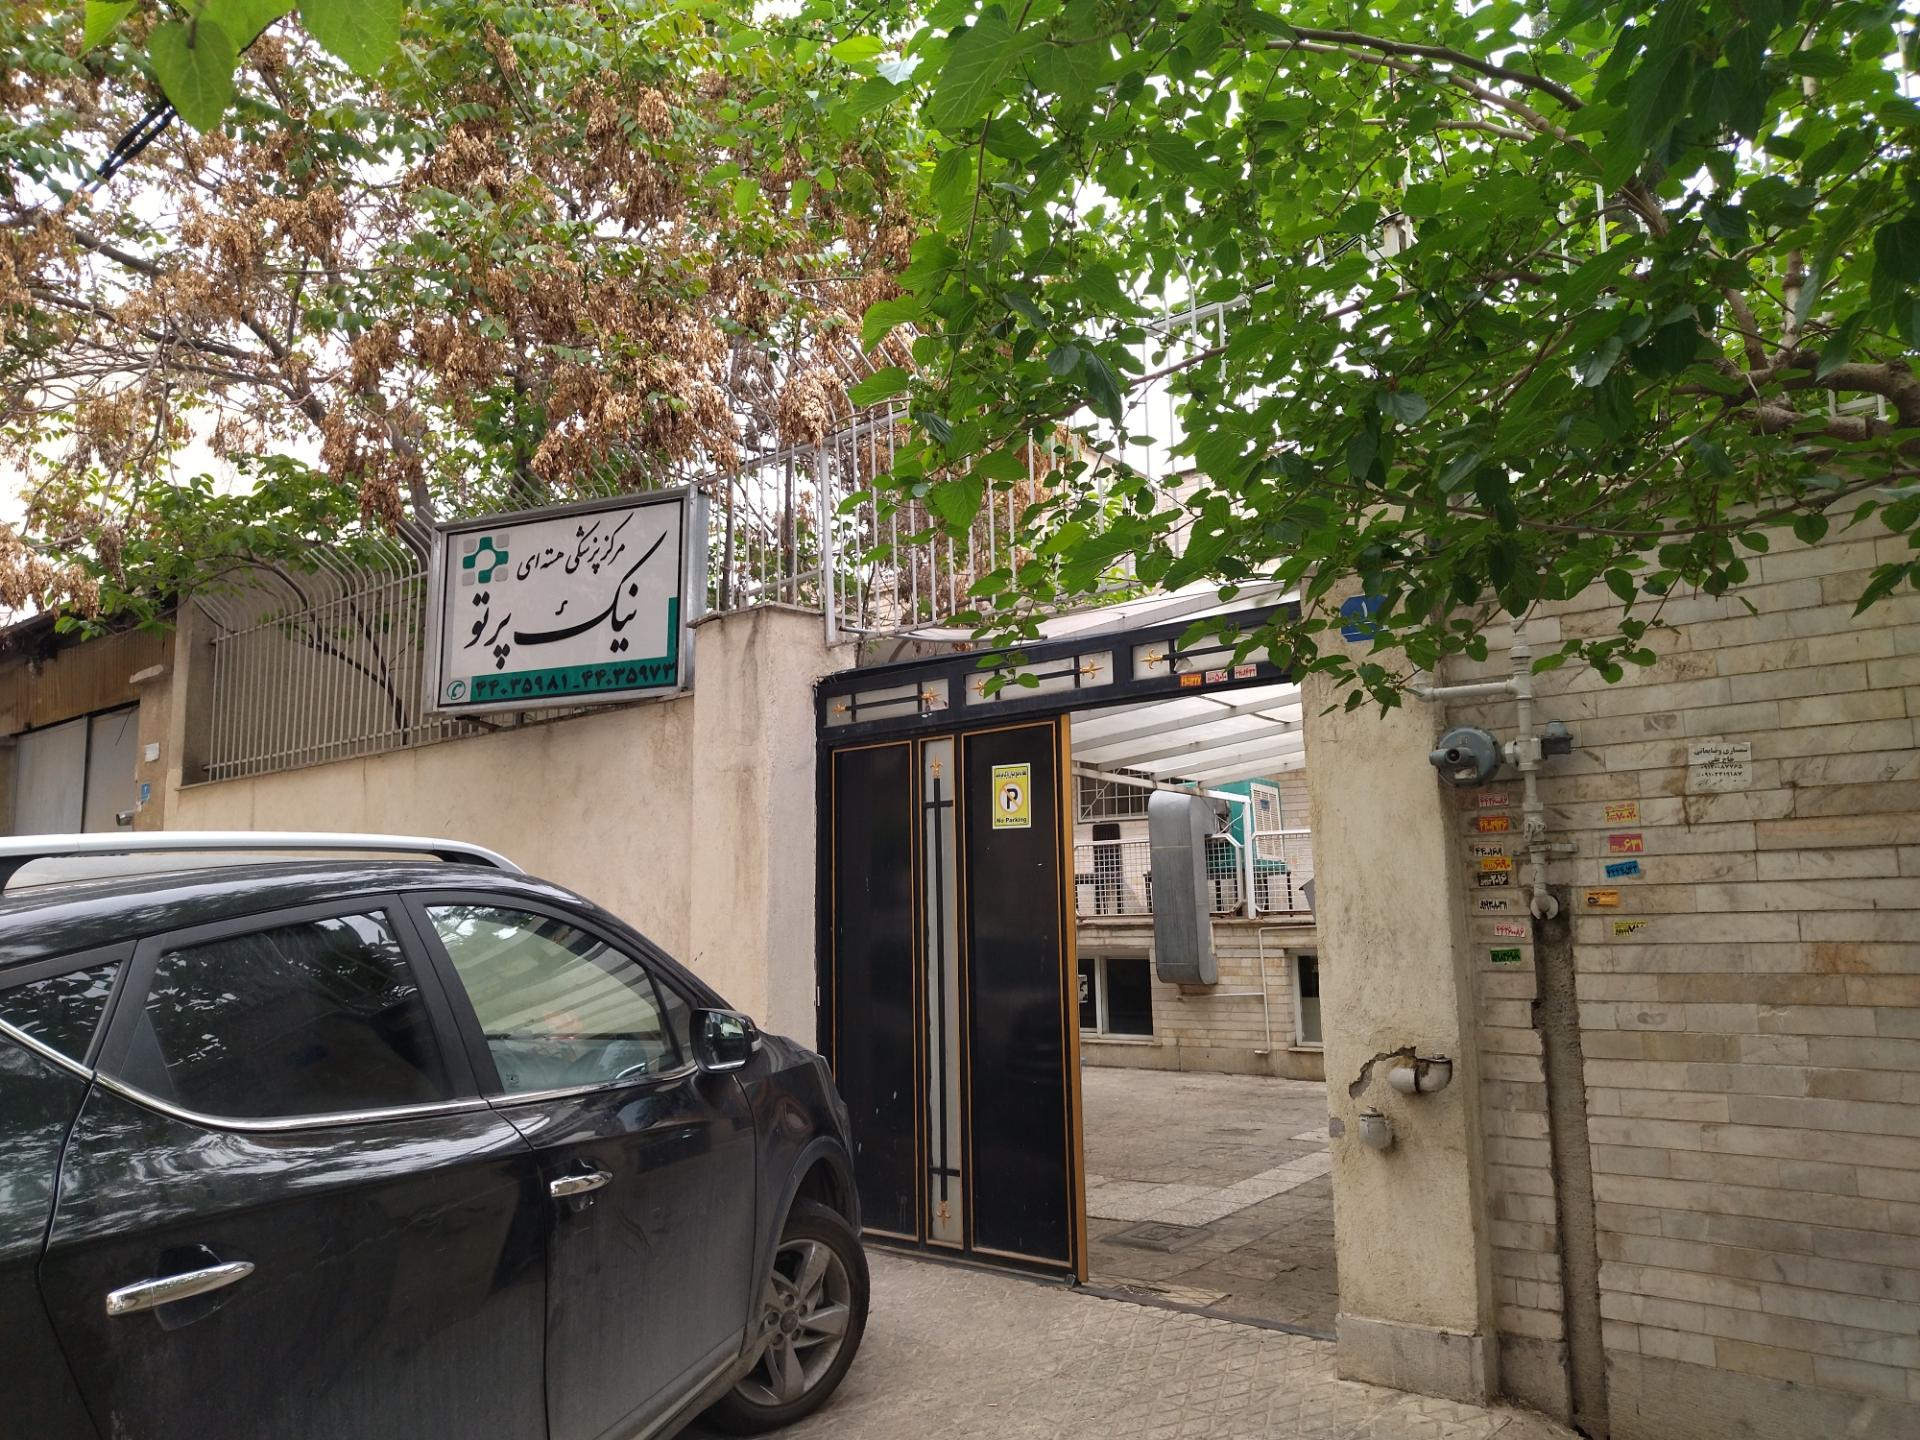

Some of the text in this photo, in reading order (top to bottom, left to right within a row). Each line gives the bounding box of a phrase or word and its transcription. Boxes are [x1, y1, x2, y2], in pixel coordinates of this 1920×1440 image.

[565, 520, 601, 574] پزشکی
[600, 512, 634, 566] مرکز
[463, 530, 668, 670] نیک پرتو
